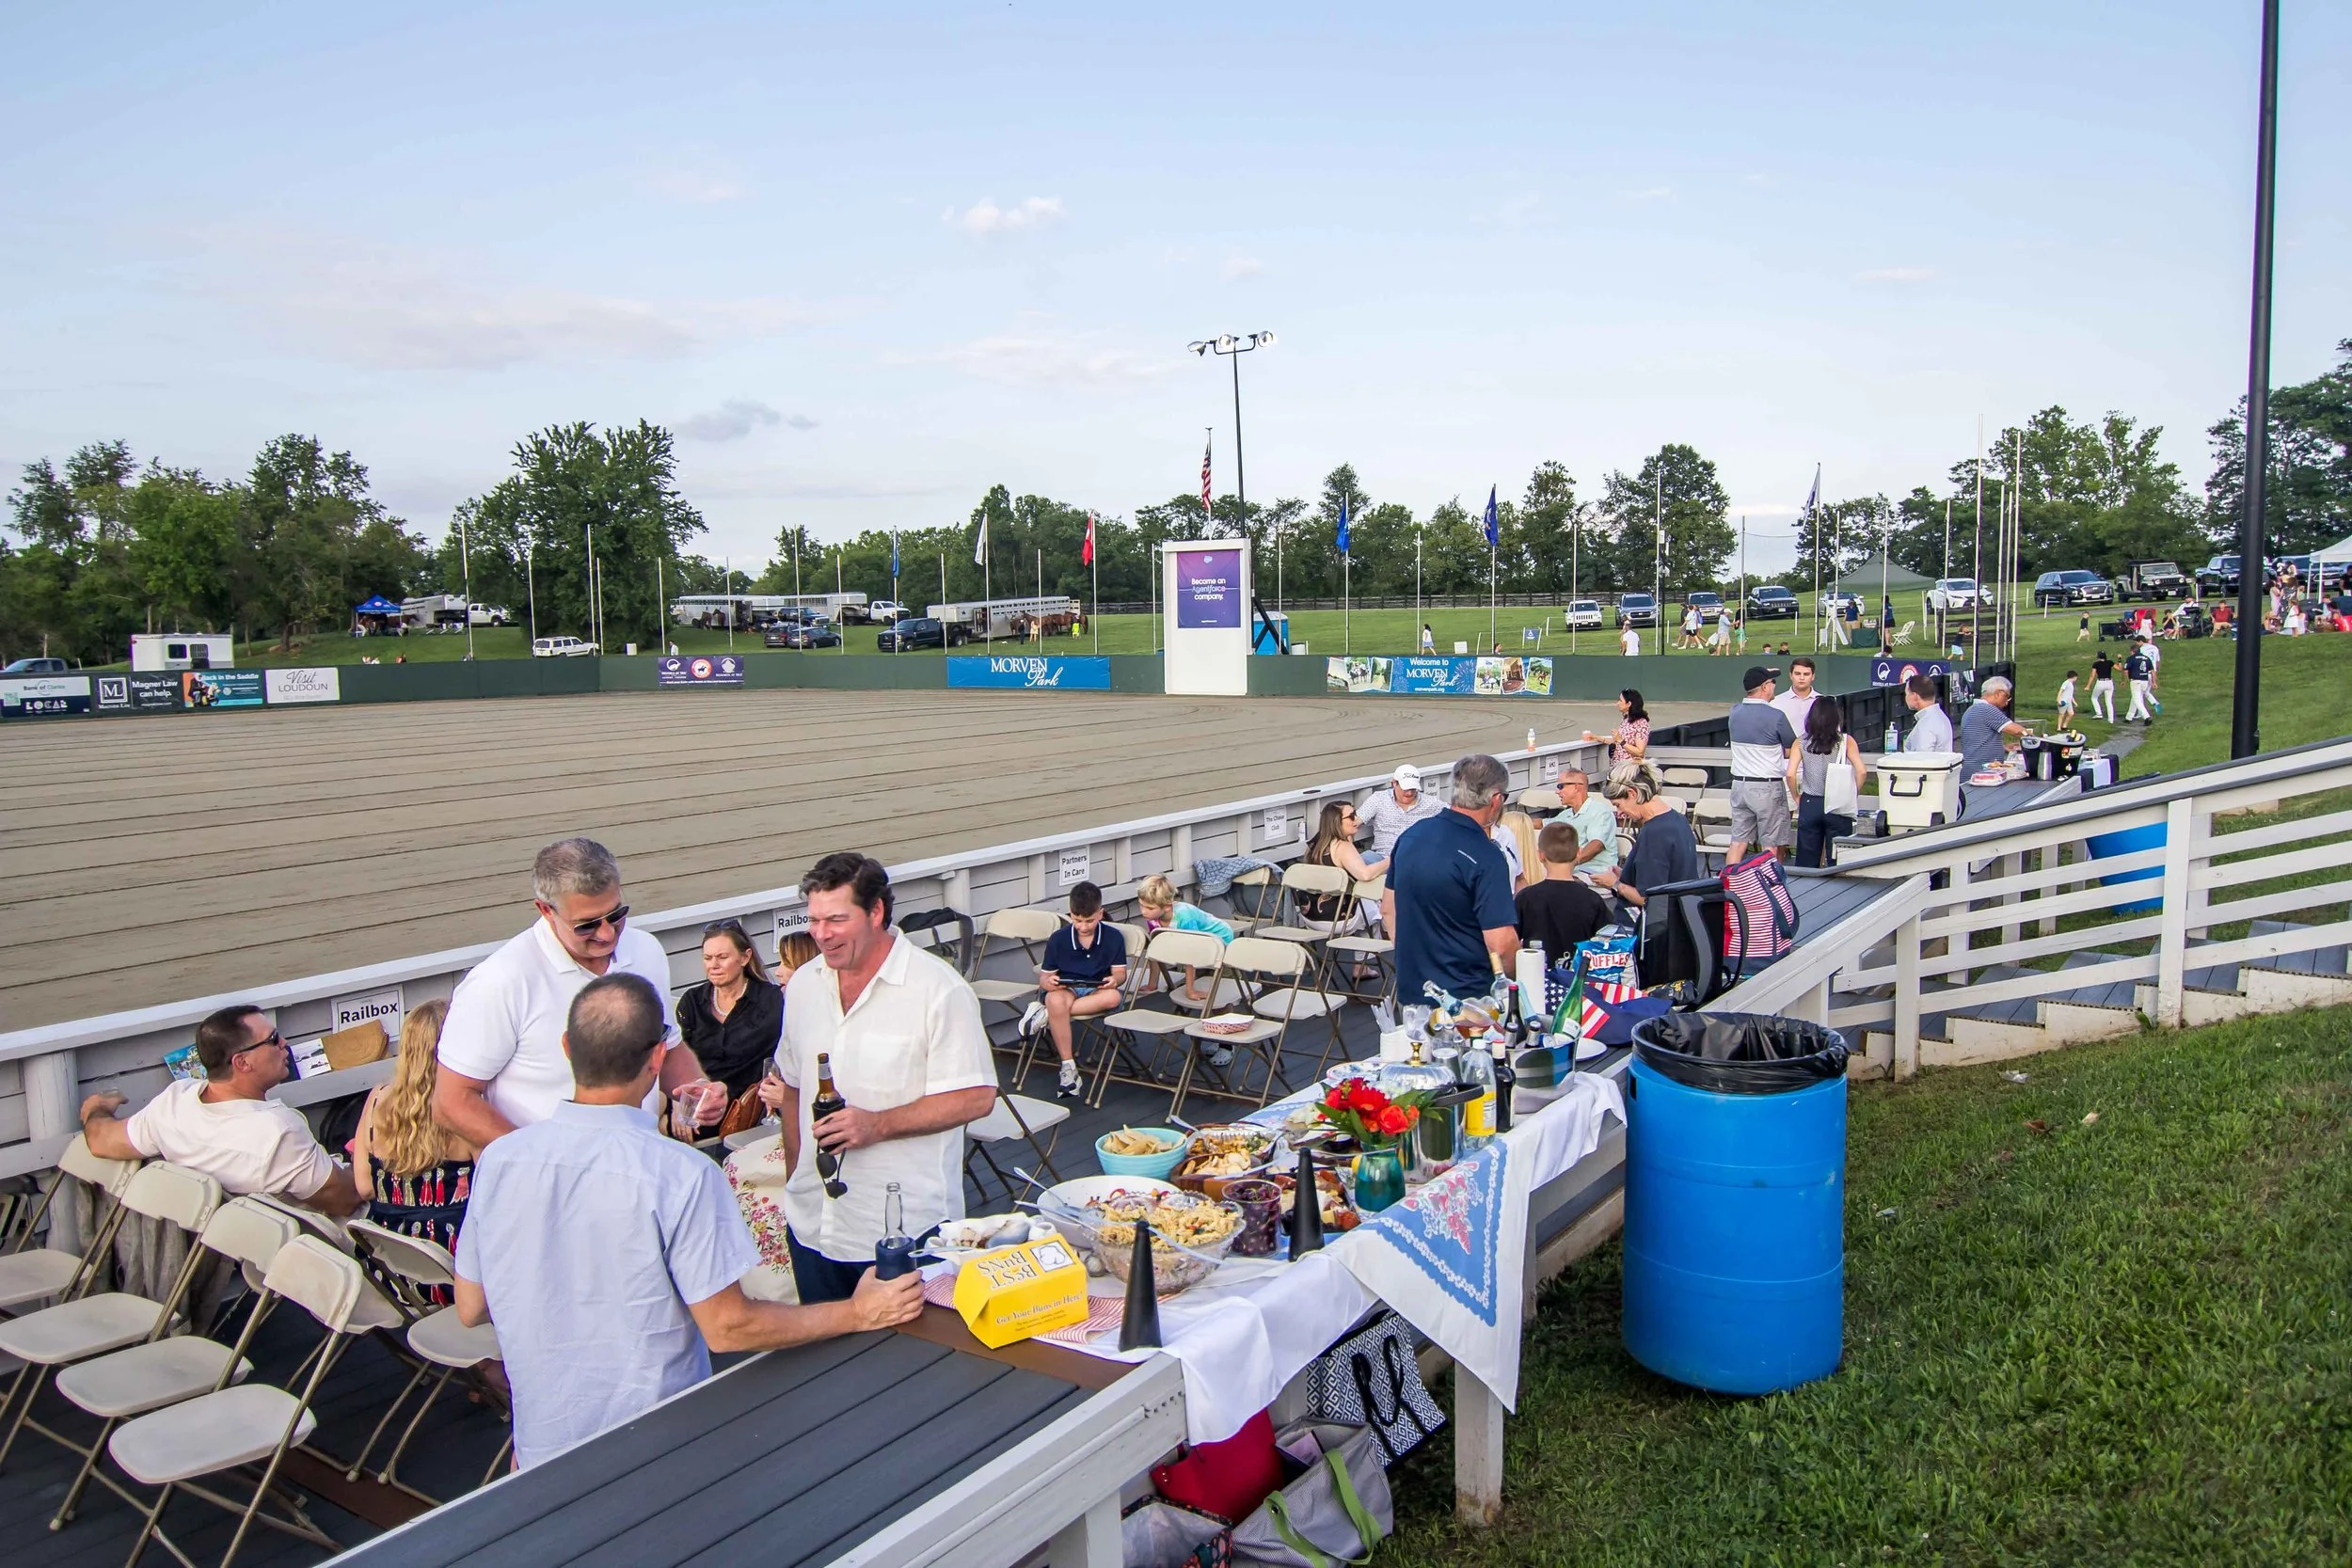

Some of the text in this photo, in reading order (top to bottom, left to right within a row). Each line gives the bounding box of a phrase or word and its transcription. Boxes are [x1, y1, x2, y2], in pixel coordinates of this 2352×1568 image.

[1192, 584, 1226, 594] Agentforce
[991, 657, 1048, 673] MORVEN
[1409, 657, 1440, 666] Welcome
[2139, 660, 2147, 673] 4
[286, 670, 318, 684] Visit
[1025, 666, 1064, 687] Park
[1406, 668, 1448, 678] MORVEN
[132, 681, 161, 689] Magner
[1431, 673, 1459, 687] Park
[278, 683, 328, 692] LOUDOUN
[1061, 855, 1088, 865] Partners
[1064, 868, 1086, 879] In Care
[777, 914, 809, 928] Railbo
[340, 1002, 398, 1024] Railbox
[1011, 1309, 1031, 1321] Your
[1032, 1303, 1054, 1314] Buns
